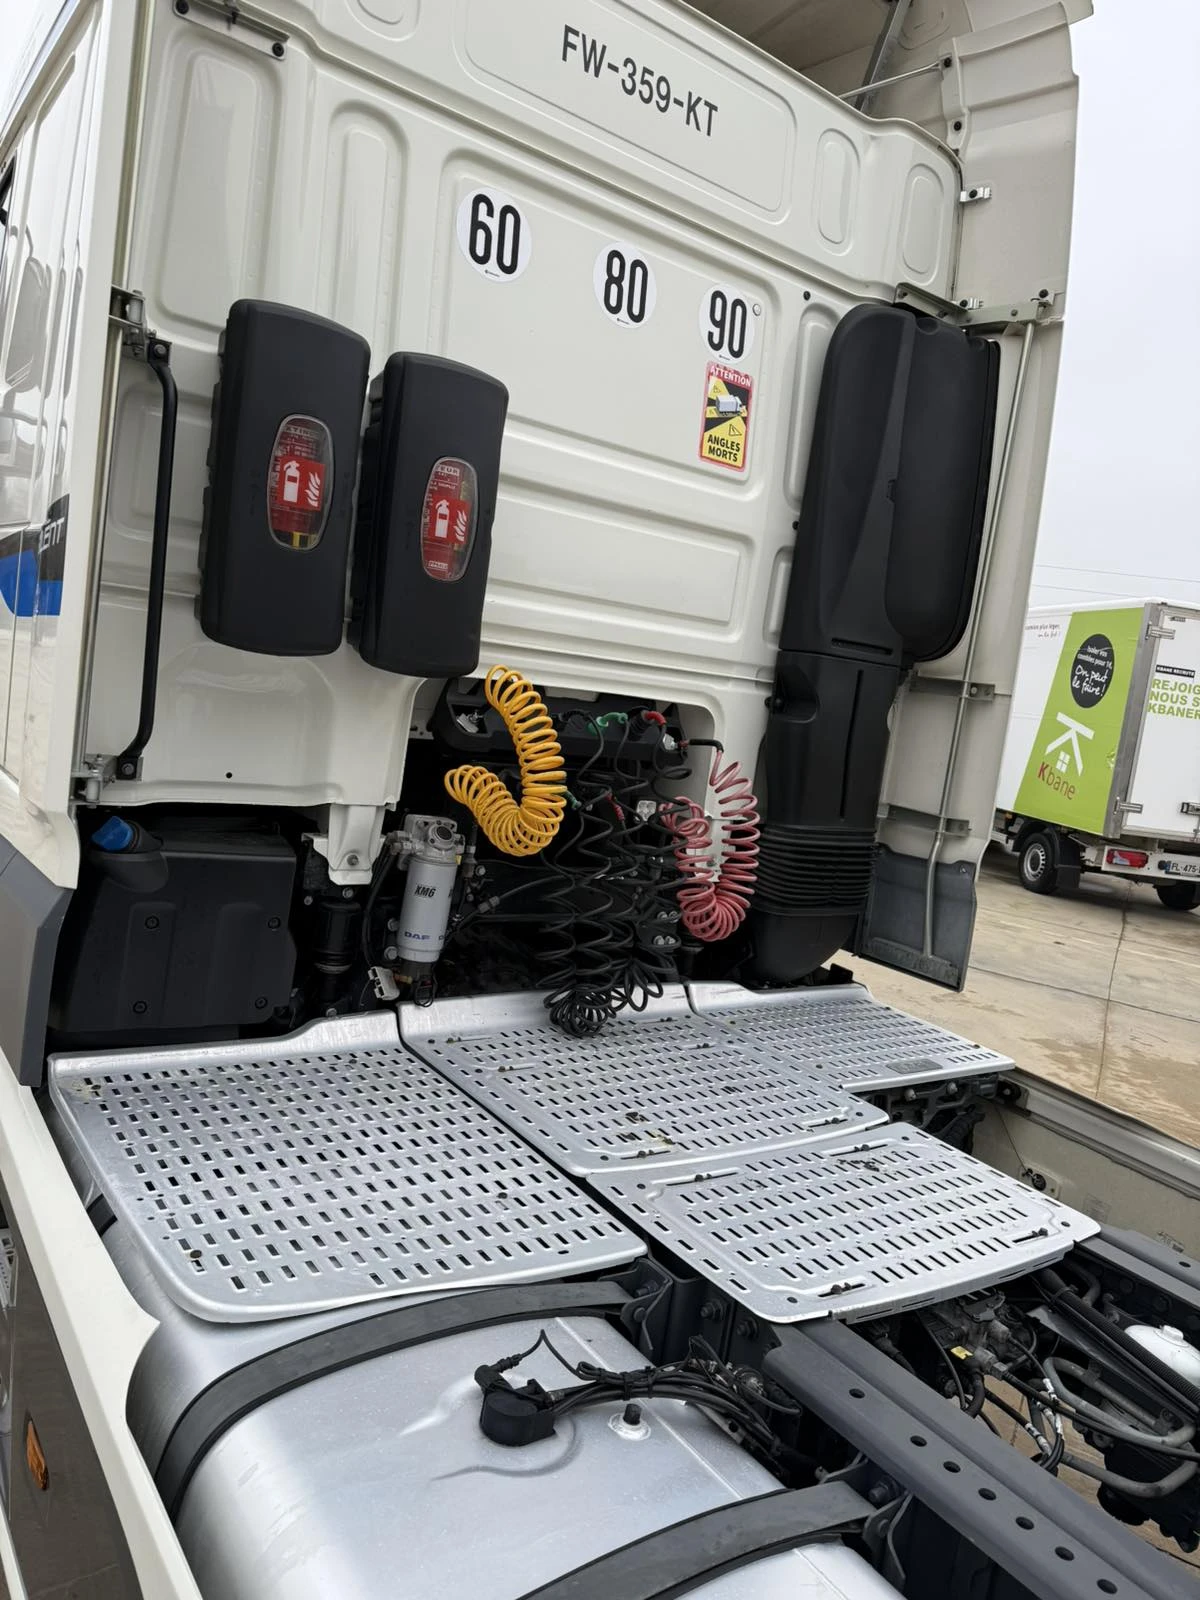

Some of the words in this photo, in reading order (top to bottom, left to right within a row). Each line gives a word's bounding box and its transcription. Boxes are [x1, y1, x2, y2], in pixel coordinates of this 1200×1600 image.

[562, 24, 718, 136] FW-359-KT
[469, 193, 521, 275] 60
[604, 249, 648, 323] 80
[707, 290, 747, 358] 90
[710, 364, 751, 387] ATTENTION
[707, 434, 741, 452] ANGLES
[708, 446, 738, 462] MORTS
[1075, 664, 1089, 677] On
[1150, 692, 1188, 706] NOUS
[1037, 761, 1076, 800] Kbane
[404, 931, 430, 941] DAF
